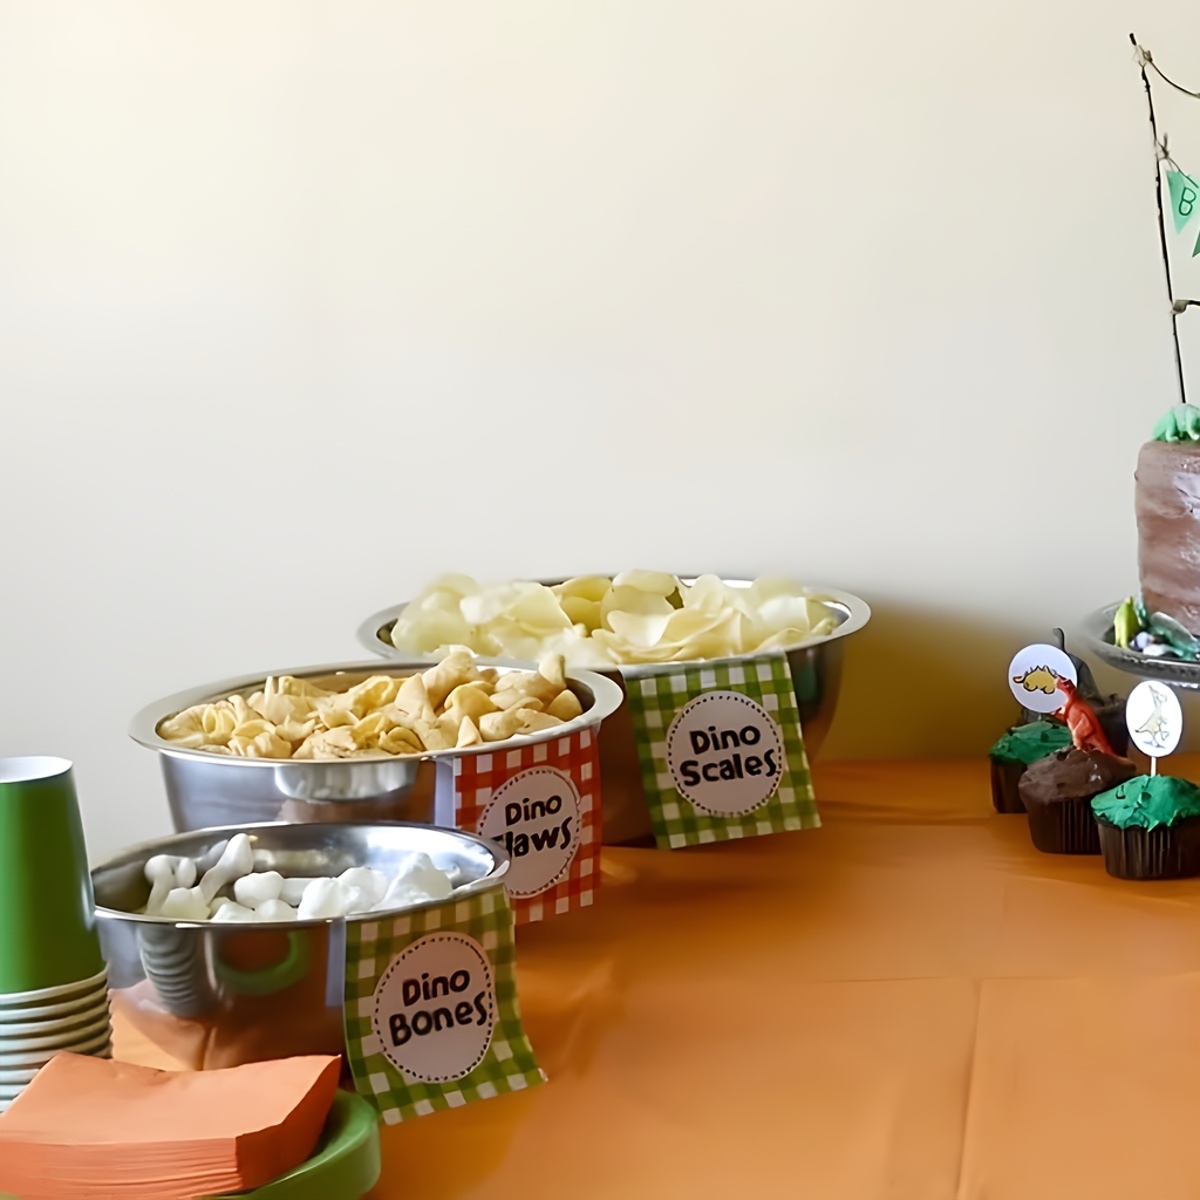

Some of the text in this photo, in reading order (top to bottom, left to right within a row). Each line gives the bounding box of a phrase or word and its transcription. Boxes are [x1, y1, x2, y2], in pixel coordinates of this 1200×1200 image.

[690, 724, 762, 755] Dino
[679, 748, 779, 788] Scales
[505, 795, 563, 827] Dino
[491, 816, 573, 859] laws
[401, 968, 472, 1007] Dino
[388, 991, 488, 1048] Bones
